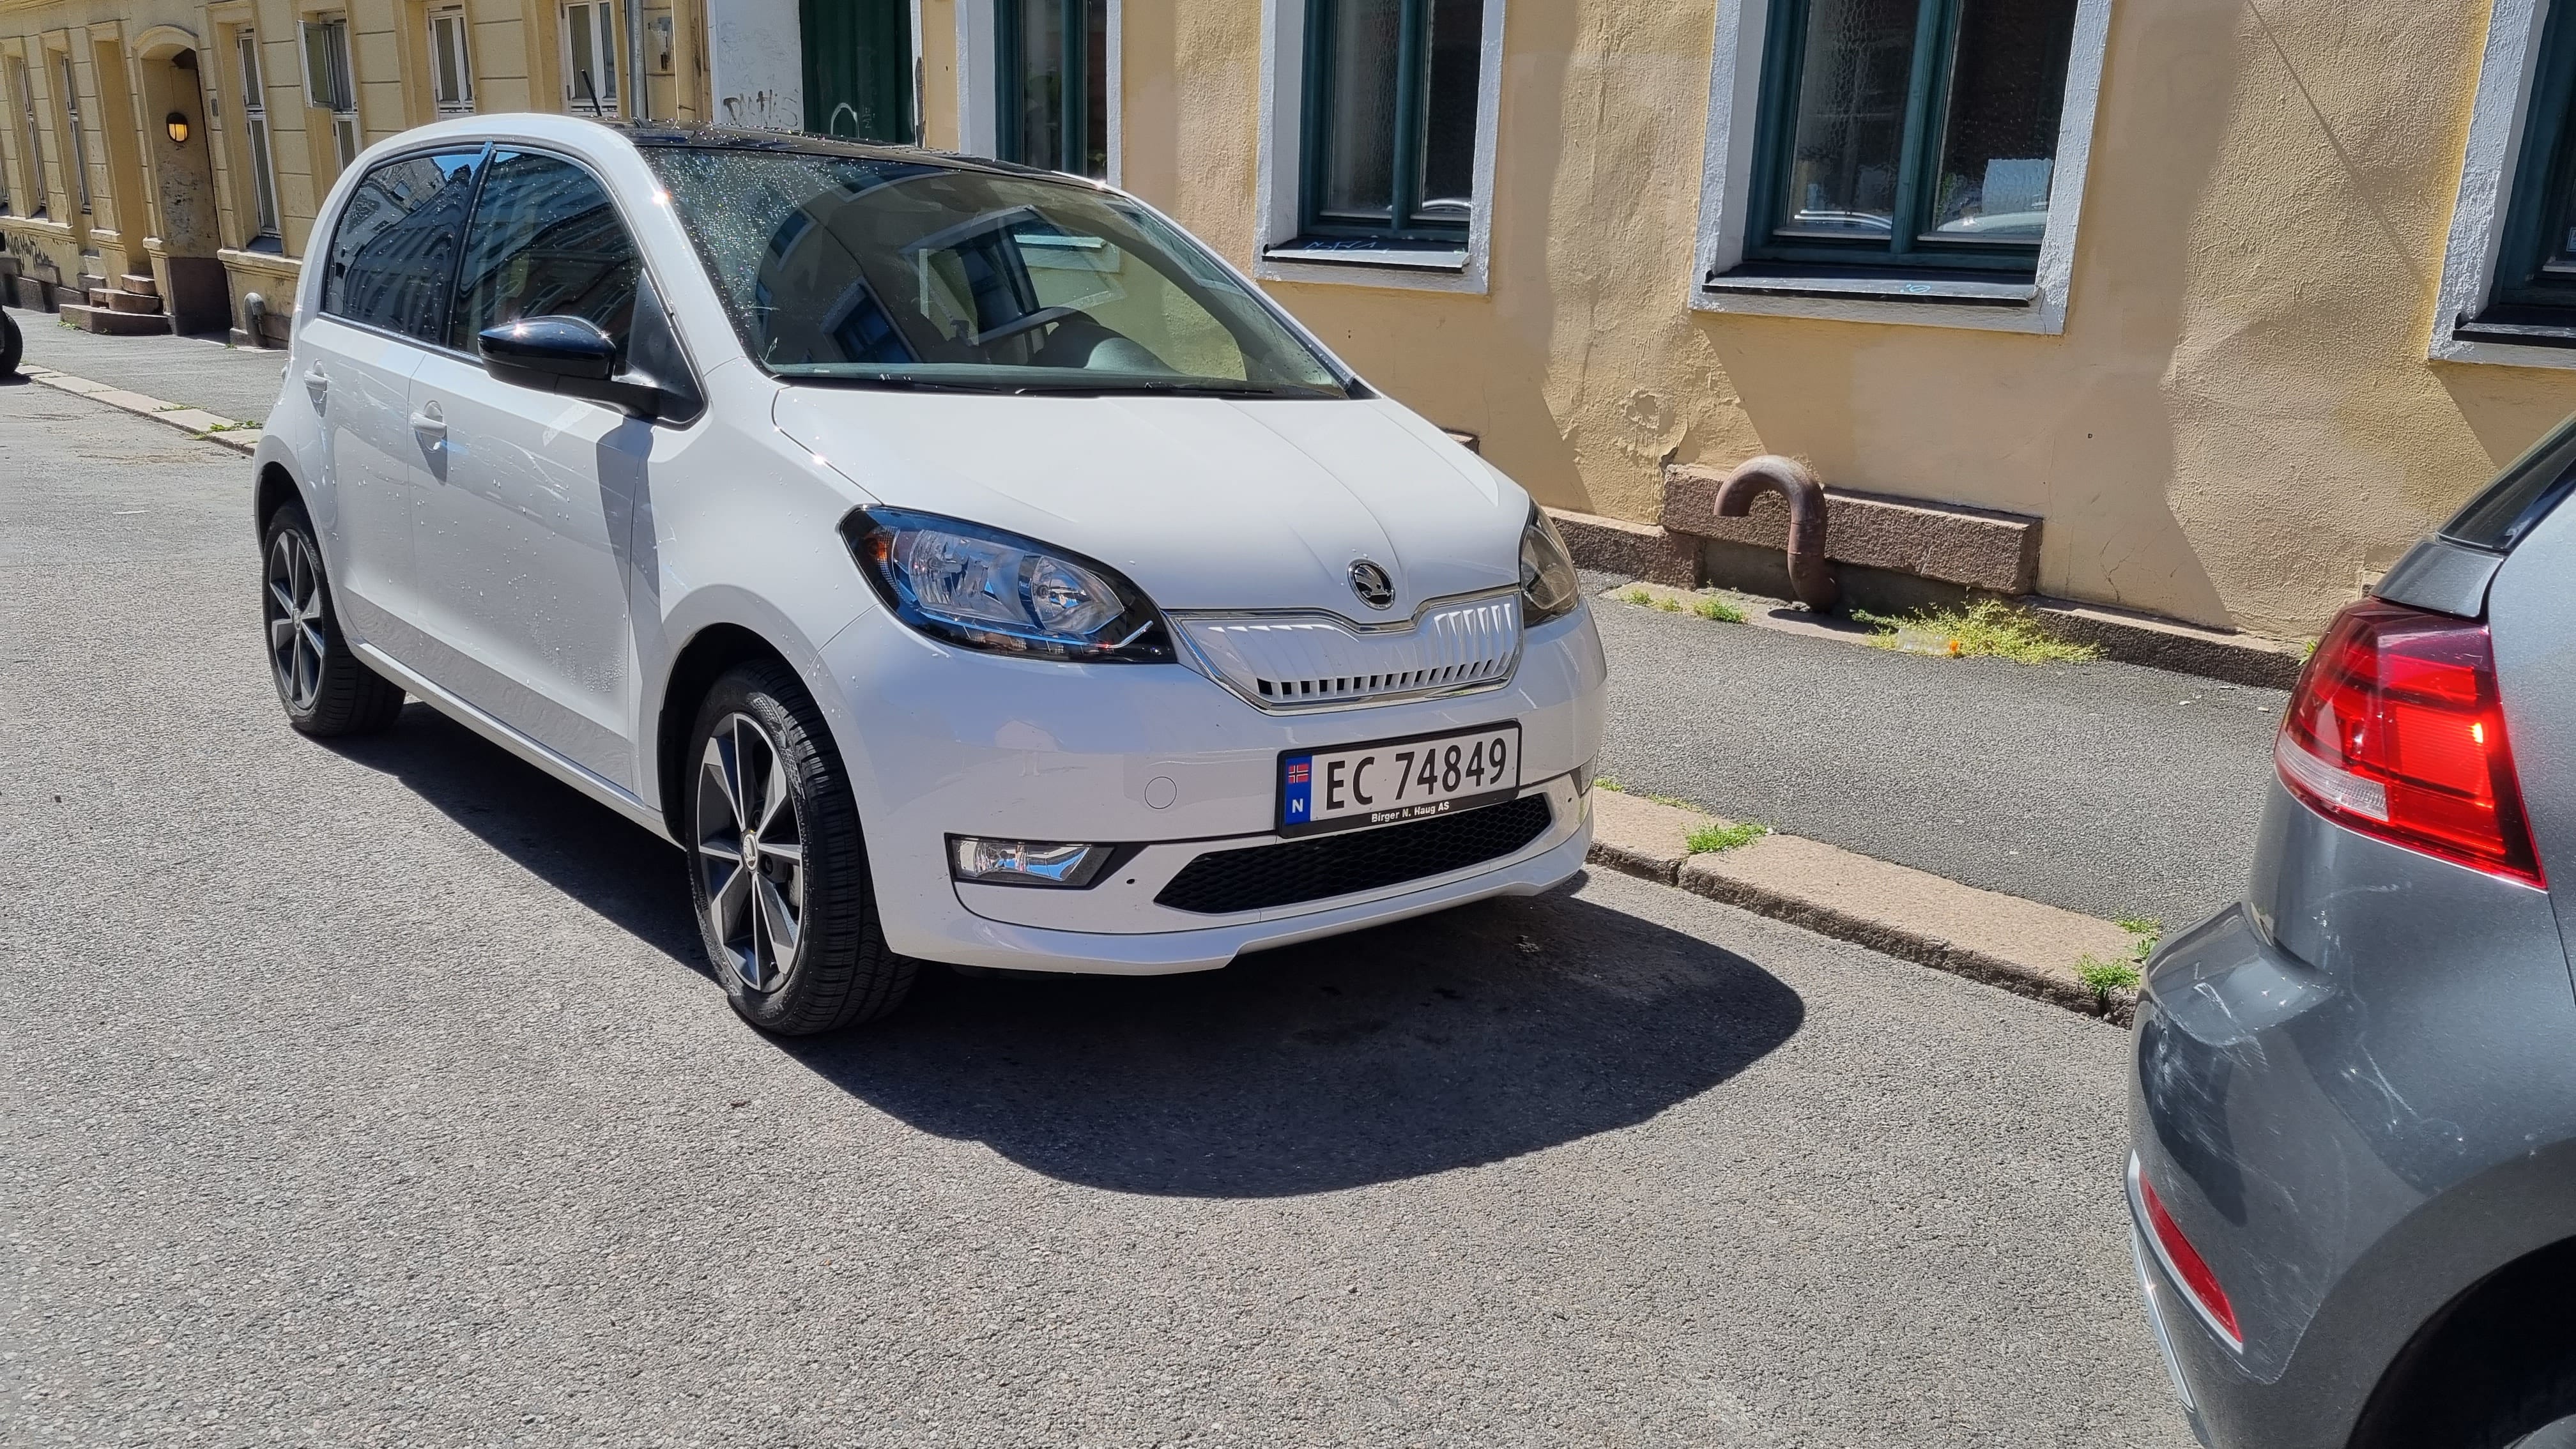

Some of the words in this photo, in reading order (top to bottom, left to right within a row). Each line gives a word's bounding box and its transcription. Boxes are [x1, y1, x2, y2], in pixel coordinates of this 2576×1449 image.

[1326, 756, 1375, 811] EC
[1395, 737, 1506, 801] 74849
[1292, 798, 1303, 813] N
[1371, 811, 1400, 823] Birger
[1402, 808, 1411, 818] N.
[1414, 806, 1436, 816] Haug
[1438, 801, 1450, 811] AS
